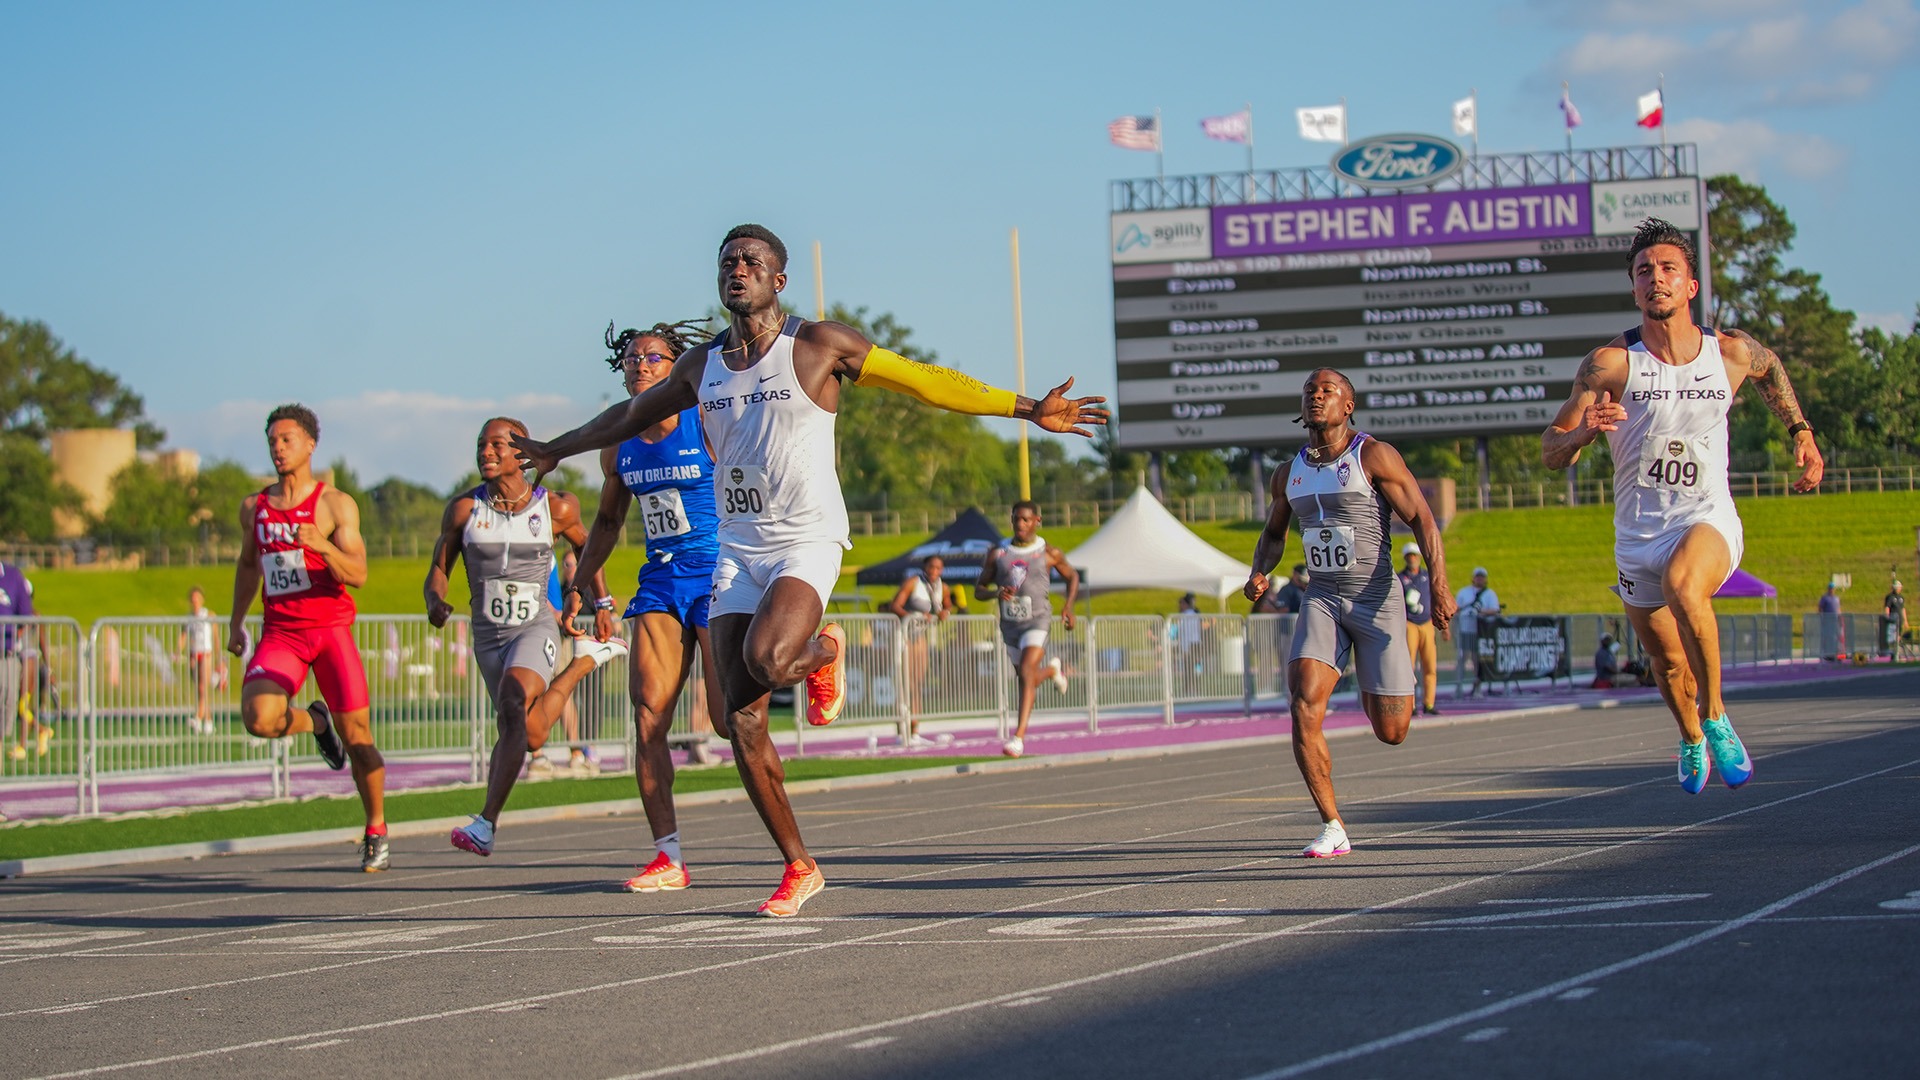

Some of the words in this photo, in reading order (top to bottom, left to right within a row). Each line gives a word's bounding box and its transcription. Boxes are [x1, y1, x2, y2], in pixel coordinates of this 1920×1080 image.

[1354, 141, 1438, 178] Ford
[1622, 191, 1692, 208] CADENCE
[1153, 222, 1205, 240] agility
[1225, 205, 1396, 248] STEPHEN
[1408, 204, 1433, 236] F.
[1444, 194, 1579, 234] AUSTIN
[1172, 260, 1238, 276] Men's
[1244, 256, 1281, 272] 100
[1286, 252, 1361, 270] Meters
[1366, 247, 1432, 266] (Univ)
[1362, 260, 1511, 282] Northwestern
[1517, 258, 1548, 273] St.
[1167, 277, 1237, 294] Evans
[1364, 284, 1465, 301] Incarnate
[1473, 281, 1532, 295] Word
[1363, 303, 1514, 325] Northwestern
[1519, 301, 1550, 315] St.
[1169, 318, 1260, 335] Beavers
[1365, 328, 1412, 342] New
[1418, 326, 1505, 340] Orleans
[1365, 350, 1416, 366] East
[1421, 347, 1485, 363] Texas
[1490, 343, 1544, 359] A&M
[1367, 367, 1515, 384] Northwestern
[1523, 364, 1552, 377] St.
[703, 396, 735, 412] EAST
[740, 389, 792, 405] TEXAS
[1174, 382, 1261, 396] Beavers
[1366, 393, 1418, 408] East
[1423, 390, 1487, 405] Texas
[1492, 385, 1546, 401] A&M
[1631, 389, 1672, 402] EAST
[1676, 389, 1726, 401] TEXAS
[1172, 403, 1226, 420] Uyar
[1369, 410, 1518, 427] Northwestern
[1525, 407, 1553, 420] St.
[622, 469, 644, 487] NEW
[644, 464, 702, 482] ORLEANS
[1647, 458, 1698, 487] 409
[725, 487, 763, 514] 390
[646, 508, 680, 535] 578
[1310, 545, 1349, 568] 616
[270, 568, 302, 590] 454
[1618, 570, 1635, 596] ET
[491, 597, 531, 620] 615
[1402, 893, 1714, 926] 7
[592, 916, 896, 944] 5
[987, 908, 1272, 936] 6
